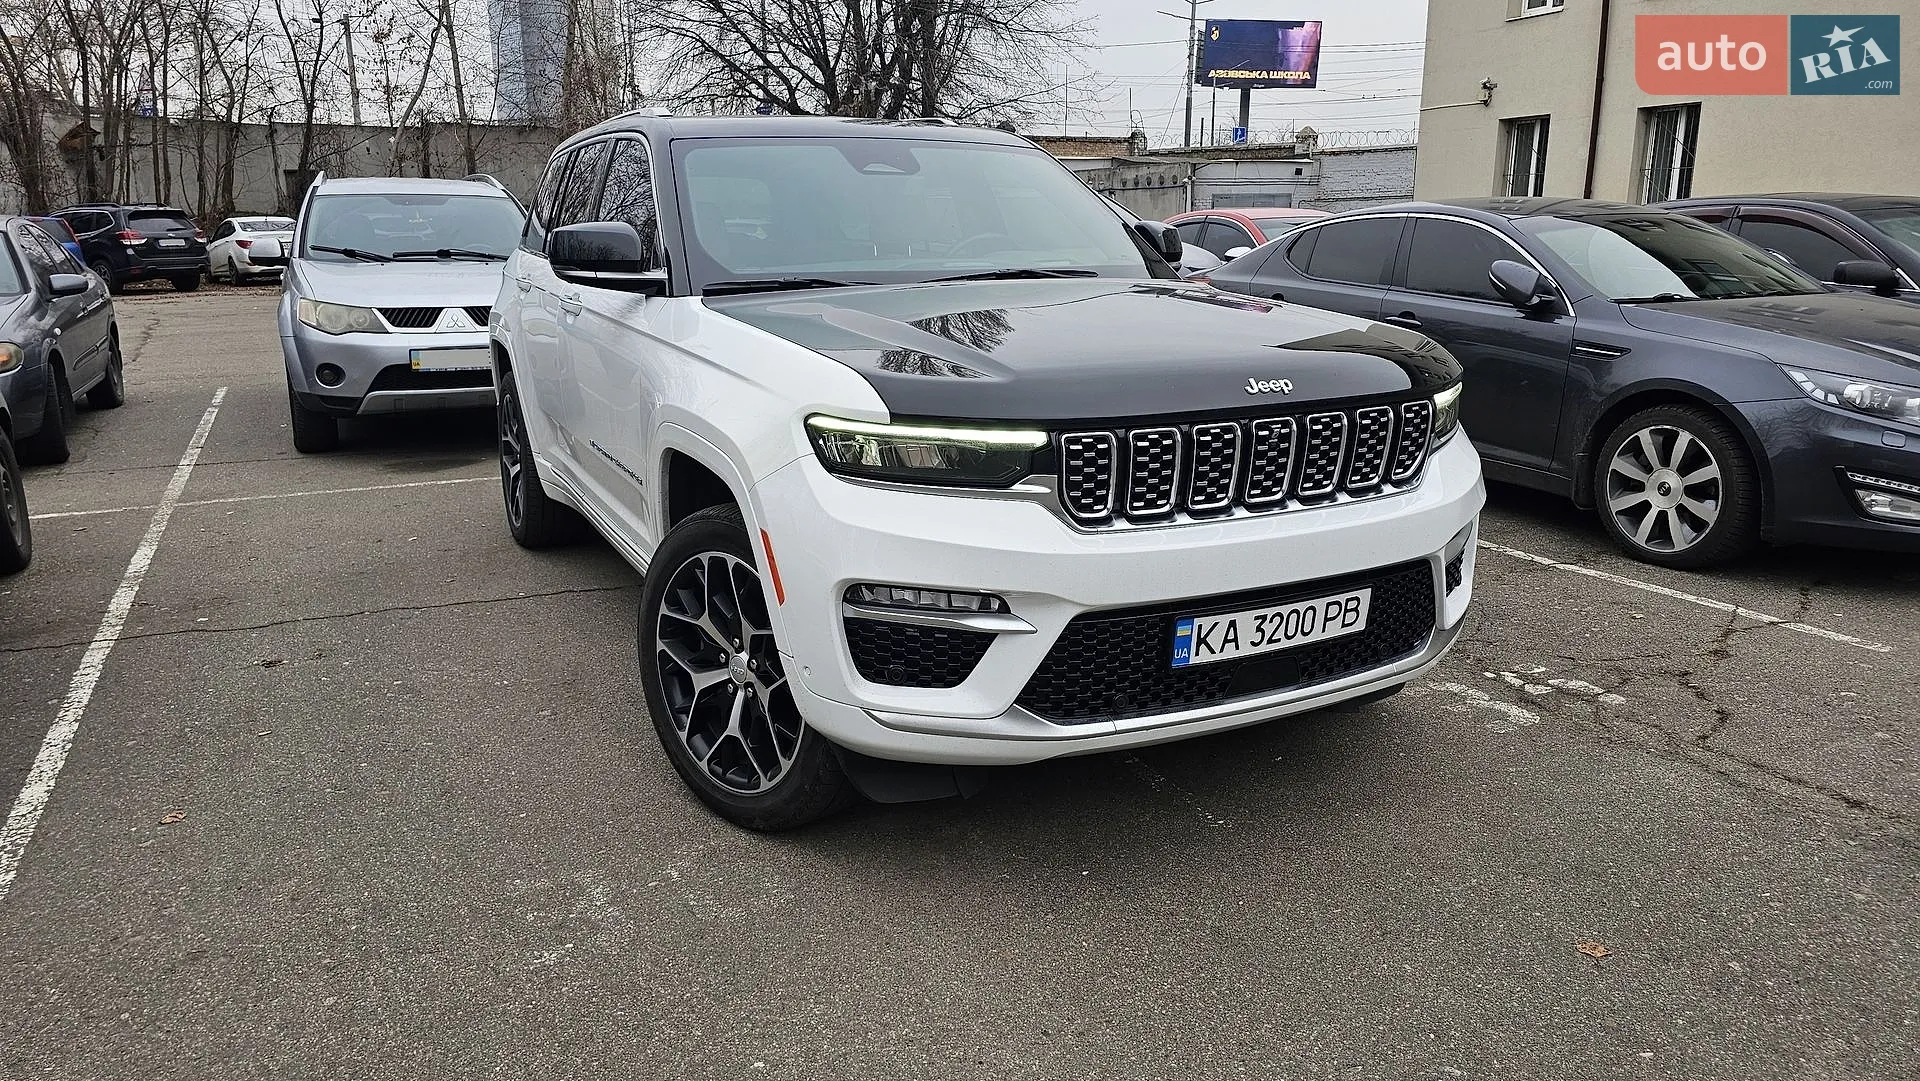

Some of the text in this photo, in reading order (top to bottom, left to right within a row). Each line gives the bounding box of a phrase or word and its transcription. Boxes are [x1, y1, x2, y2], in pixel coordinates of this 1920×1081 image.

[1208, 69, 1311, 80] АЗОВСЬКА ШКОЛА
[1244, 377, 1293, 394] Jeep
[1194, 595, 1362, 657] KA 3200 PB
[1174, 648, 1189, 659] UA
